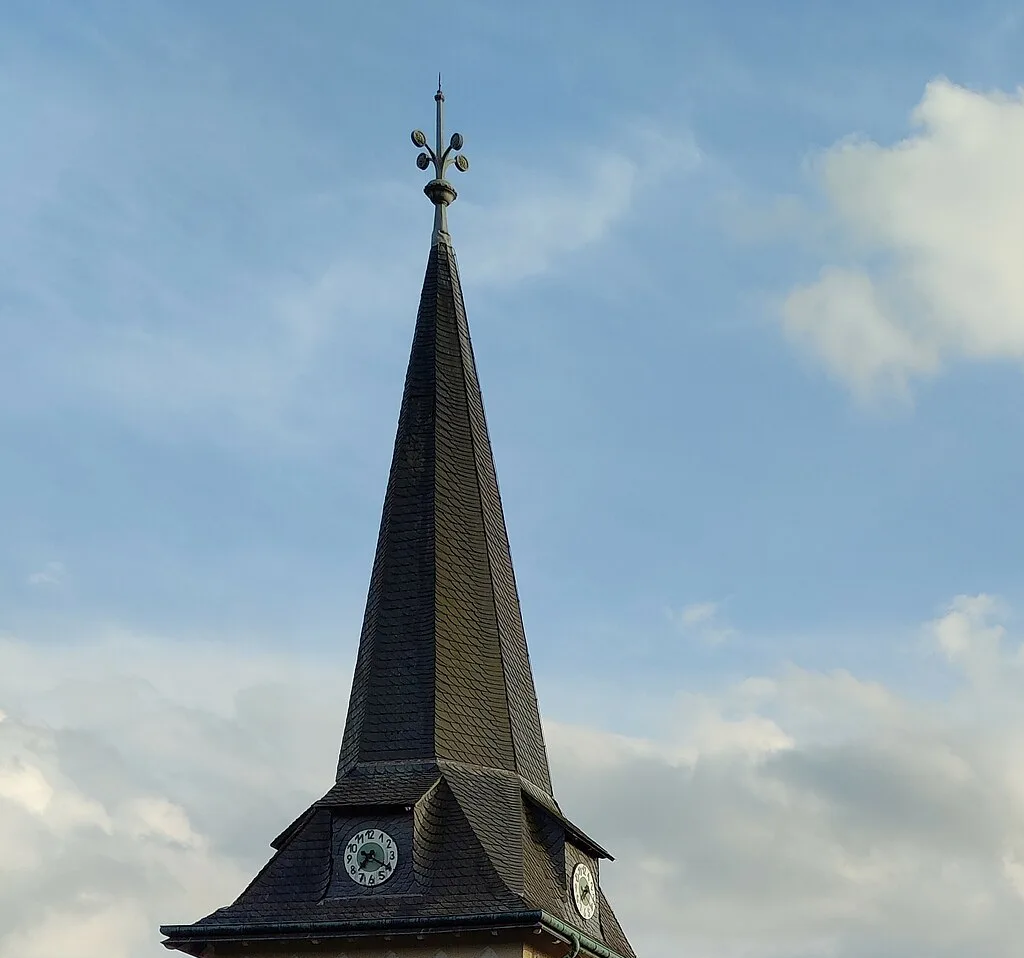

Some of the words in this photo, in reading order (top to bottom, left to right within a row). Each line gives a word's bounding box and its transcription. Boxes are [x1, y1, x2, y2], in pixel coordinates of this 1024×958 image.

[355, 834, 364, 844] 11
[365, 830, 374, 839] 12
[379, 834, 384, 842] 1
[386, 839, 392, 848] 2
[347, 844, 357, 853] 10
[347, 855, 352, 864] 9
[390, 851, 395, 860] 3
[350, 865, 356, 874] 8
[358, 873, 364, 882] 7
[368, 874, 375, 884] 6
[378, 871, 385, 880] 5
